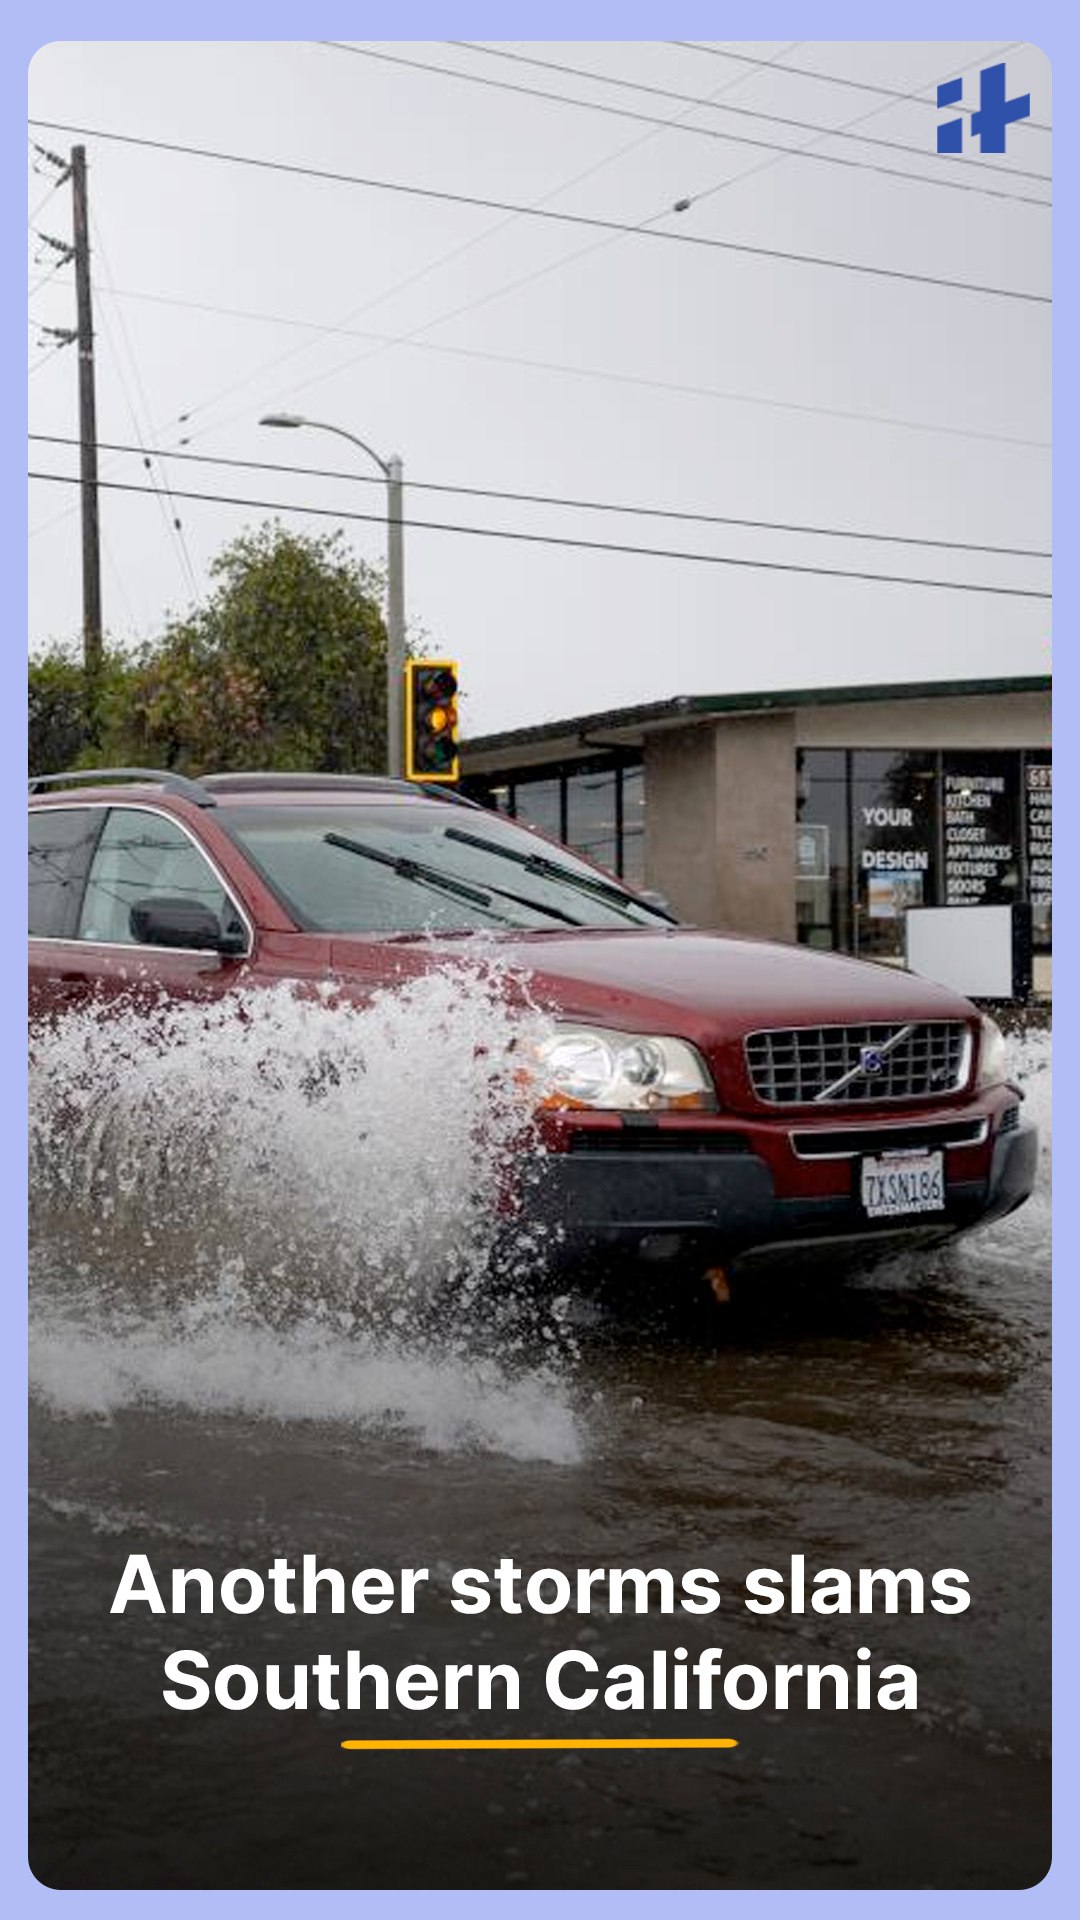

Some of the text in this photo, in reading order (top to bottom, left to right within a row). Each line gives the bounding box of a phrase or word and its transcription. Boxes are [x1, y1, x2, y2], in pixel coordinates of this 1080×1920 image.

[945, 777, 1004, 791] FURNITURE
[945, 793, 991, 808] KITCHEN
[862, 807, 913, 827] YOUR
[945, 811, 975, 825] BATH
[945, 827, 986, 841] CLOSET
[946, 844, 1012, 860] APPLIANCES
[862, 851, 929, 870] DESIGN
[945, 861, 998, 877] FIXTURES
[946, 880, 987, 894] DOORS
[865, 1170, 941, 1206] 7XSN186
